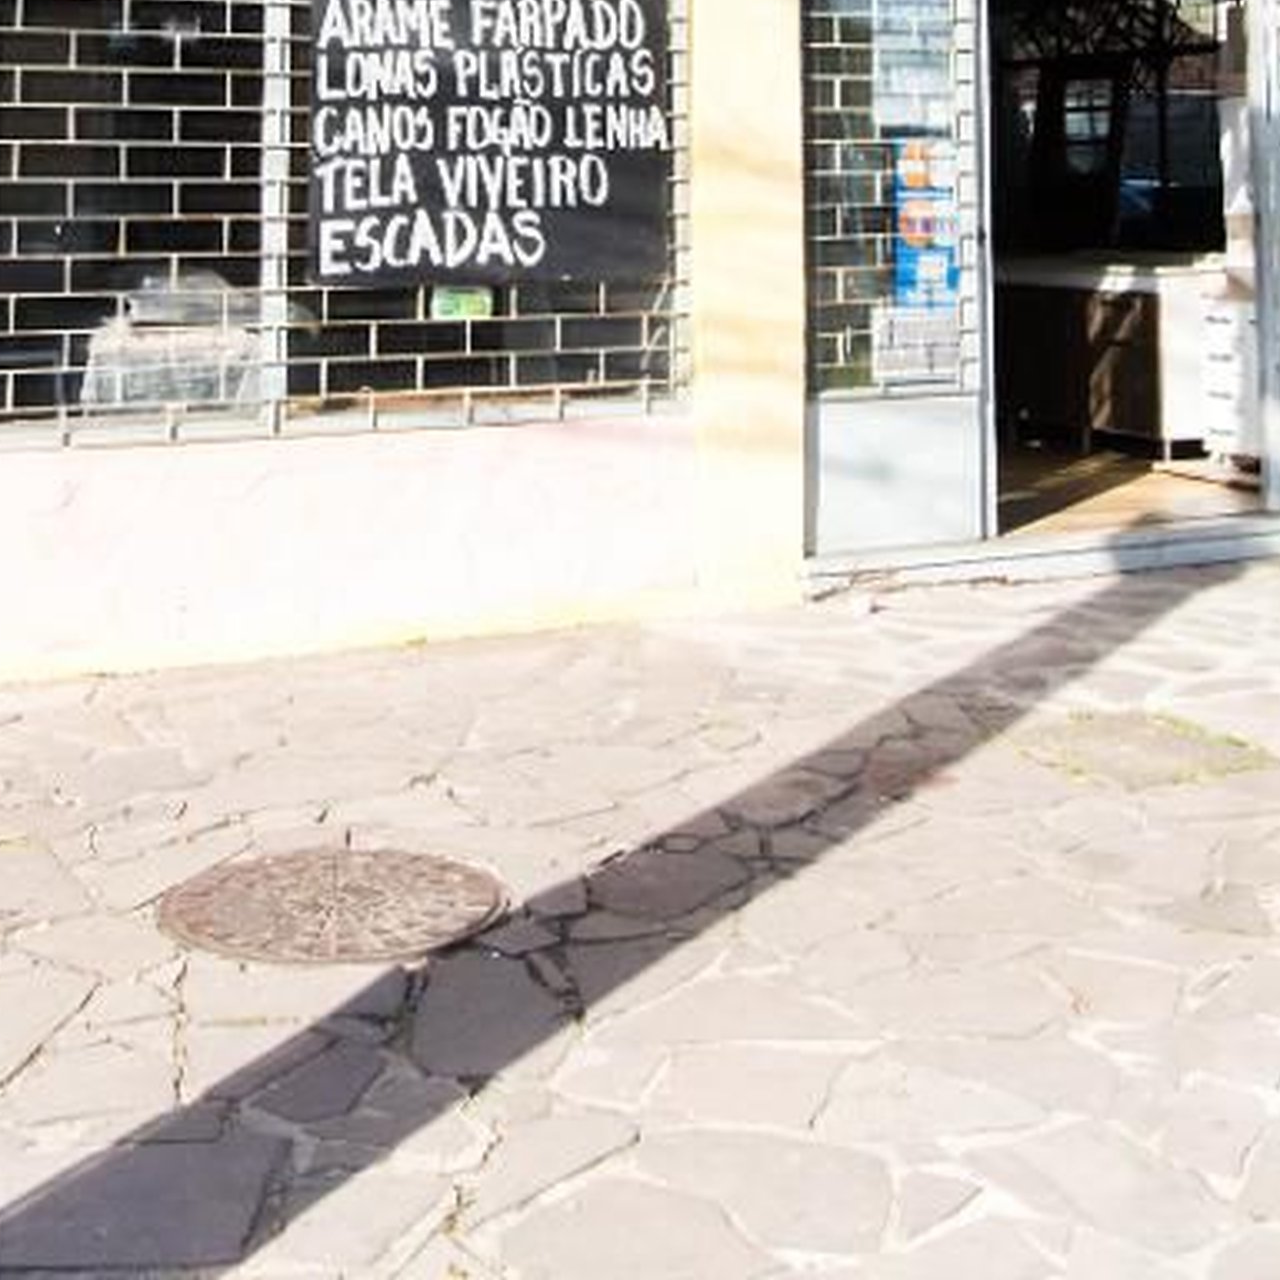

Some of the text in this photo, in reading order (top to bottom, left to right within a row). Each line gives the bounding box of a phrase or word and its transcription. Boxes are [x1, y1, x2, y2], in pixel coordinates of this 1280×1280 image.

[318, 49, 437, 100] LONAS
[314, 106, 434, 155] CANOS
[563, 106, 669, 151] LENHA
[314, 153, 608, 213] TELA VIVEIRO
[319, 210, 546, 276] ESCADAS
